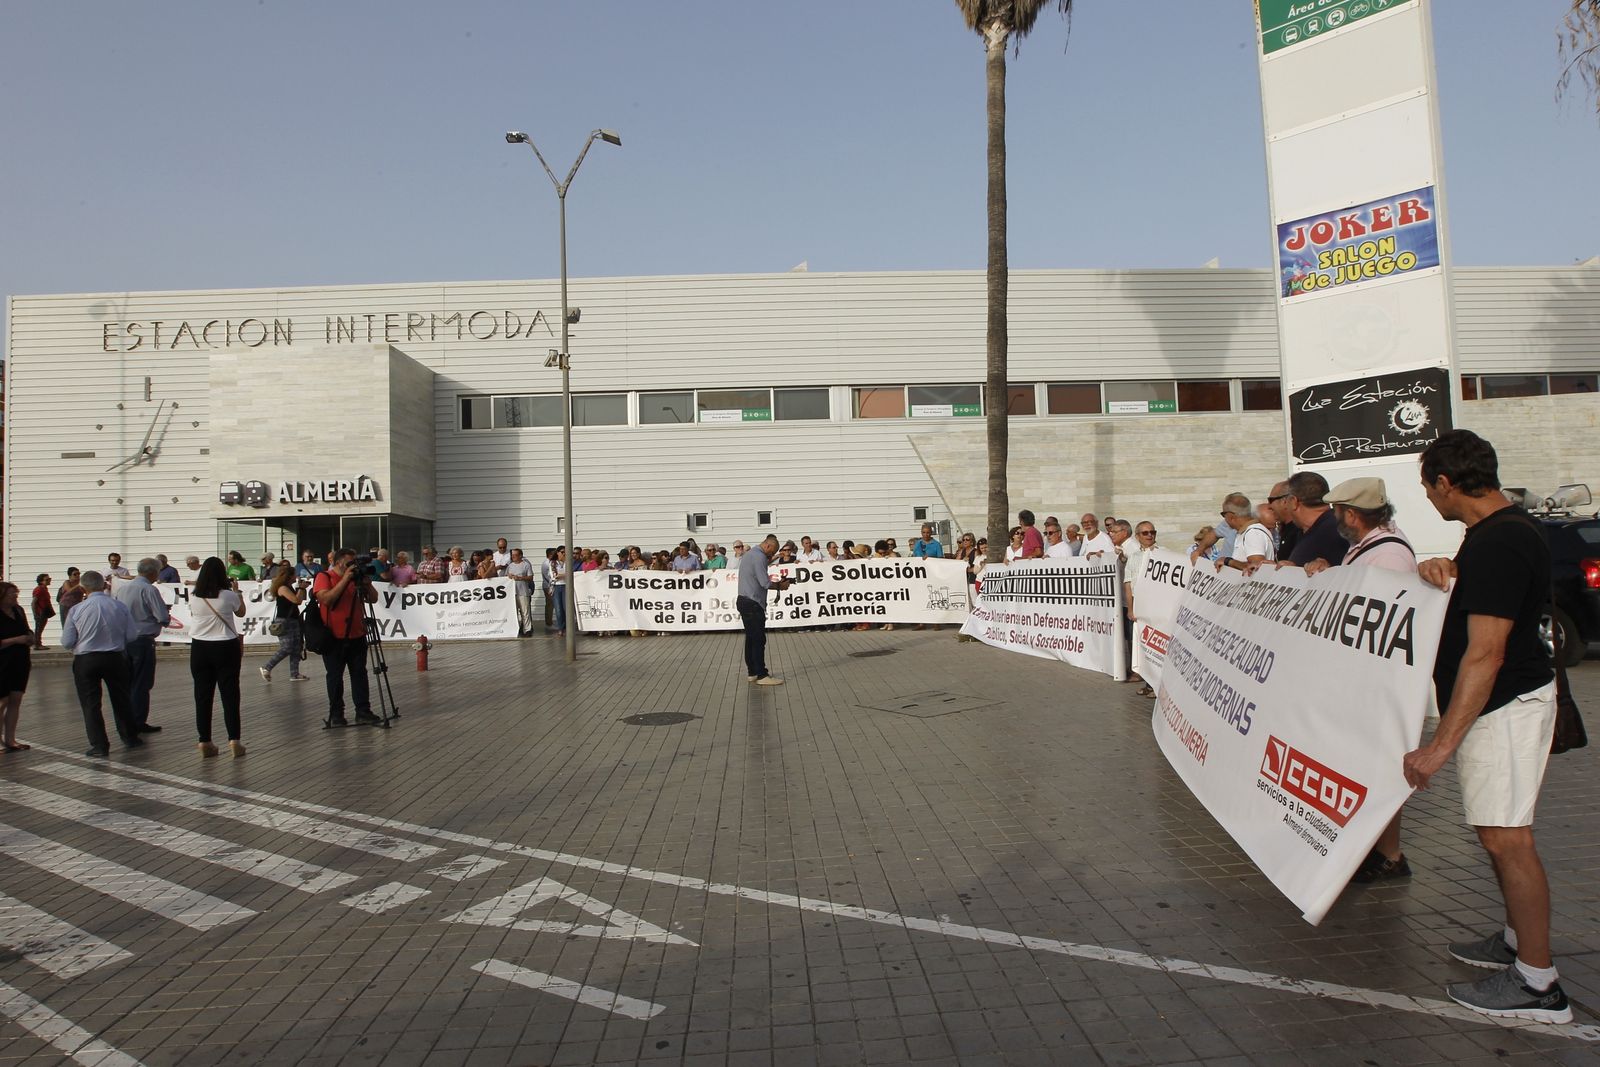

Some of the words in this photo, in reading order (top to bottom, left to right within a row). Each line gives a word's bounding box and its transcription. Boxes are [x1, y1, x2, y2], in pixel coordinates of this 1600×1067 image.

[1287, 0, 1315, 19] Área
[1286, 199, 1430, 250] JOKER
[1302, 272, 1331, 291] de
[1334, 251, 1397, 285] JUEGO
[1318, 236, 1395, 270] SALON
[103, 317, 292, 351] ESTACION
[325, 309, 576, 344] INTERMODA
[1338, 380, 1437, 411] Estación
[279, 474, 377, 503] ALMERÍA
[608, 574, 719, 590] Buscando
[795, 567, 824, 584] De
[832, 562, 927, 581] Solución
[383, 590, 397, 609] y
[401, 585, 508, 611] promesas
[629, 598, 679, 611] Mesa
[681, 600, 702, 611] en
[784, 592, 810, 607] del
[816, 588, 911, 604] Ferrocarril
[654, 611, 675, 624] de
[681, 611, 697, 624] la
[789, 607, 812, 620] de
[817, 602, 887, 618] Almería
[1144, 558, 1171, 584] POR
[1171, 565, 1186, 589] EL
[1187, 569, 1216, 598] MPLEO
[1297, 589, 1416, 667] ALMERÍA
[1021, 614, 1032, 626] en
[1033, 612, 1070, 630] Defensa
[1071, 614, 1086, 631] del
[1009, 629, 1029, 646] Social
[1035, 633, 1085, 654] Sostenible
[1229, 634, 1276, 684] CALIDAD
[1198, 671, 1257, 737] MODERNAS
[1176, 718, 1209, 767] ALMERÍA
[1286, 758, 1360, 818] CCOO
[1256, 778, 1288, 807] servicios
[1288, 800, 1295, 812] a
[1296, 801, 1304, 818] la
[1304, 810, 1338, 843] ciudadanía
[1282, 812, 1304, 836] Almería
[1301, 827, 1329, 858] ferroviario
